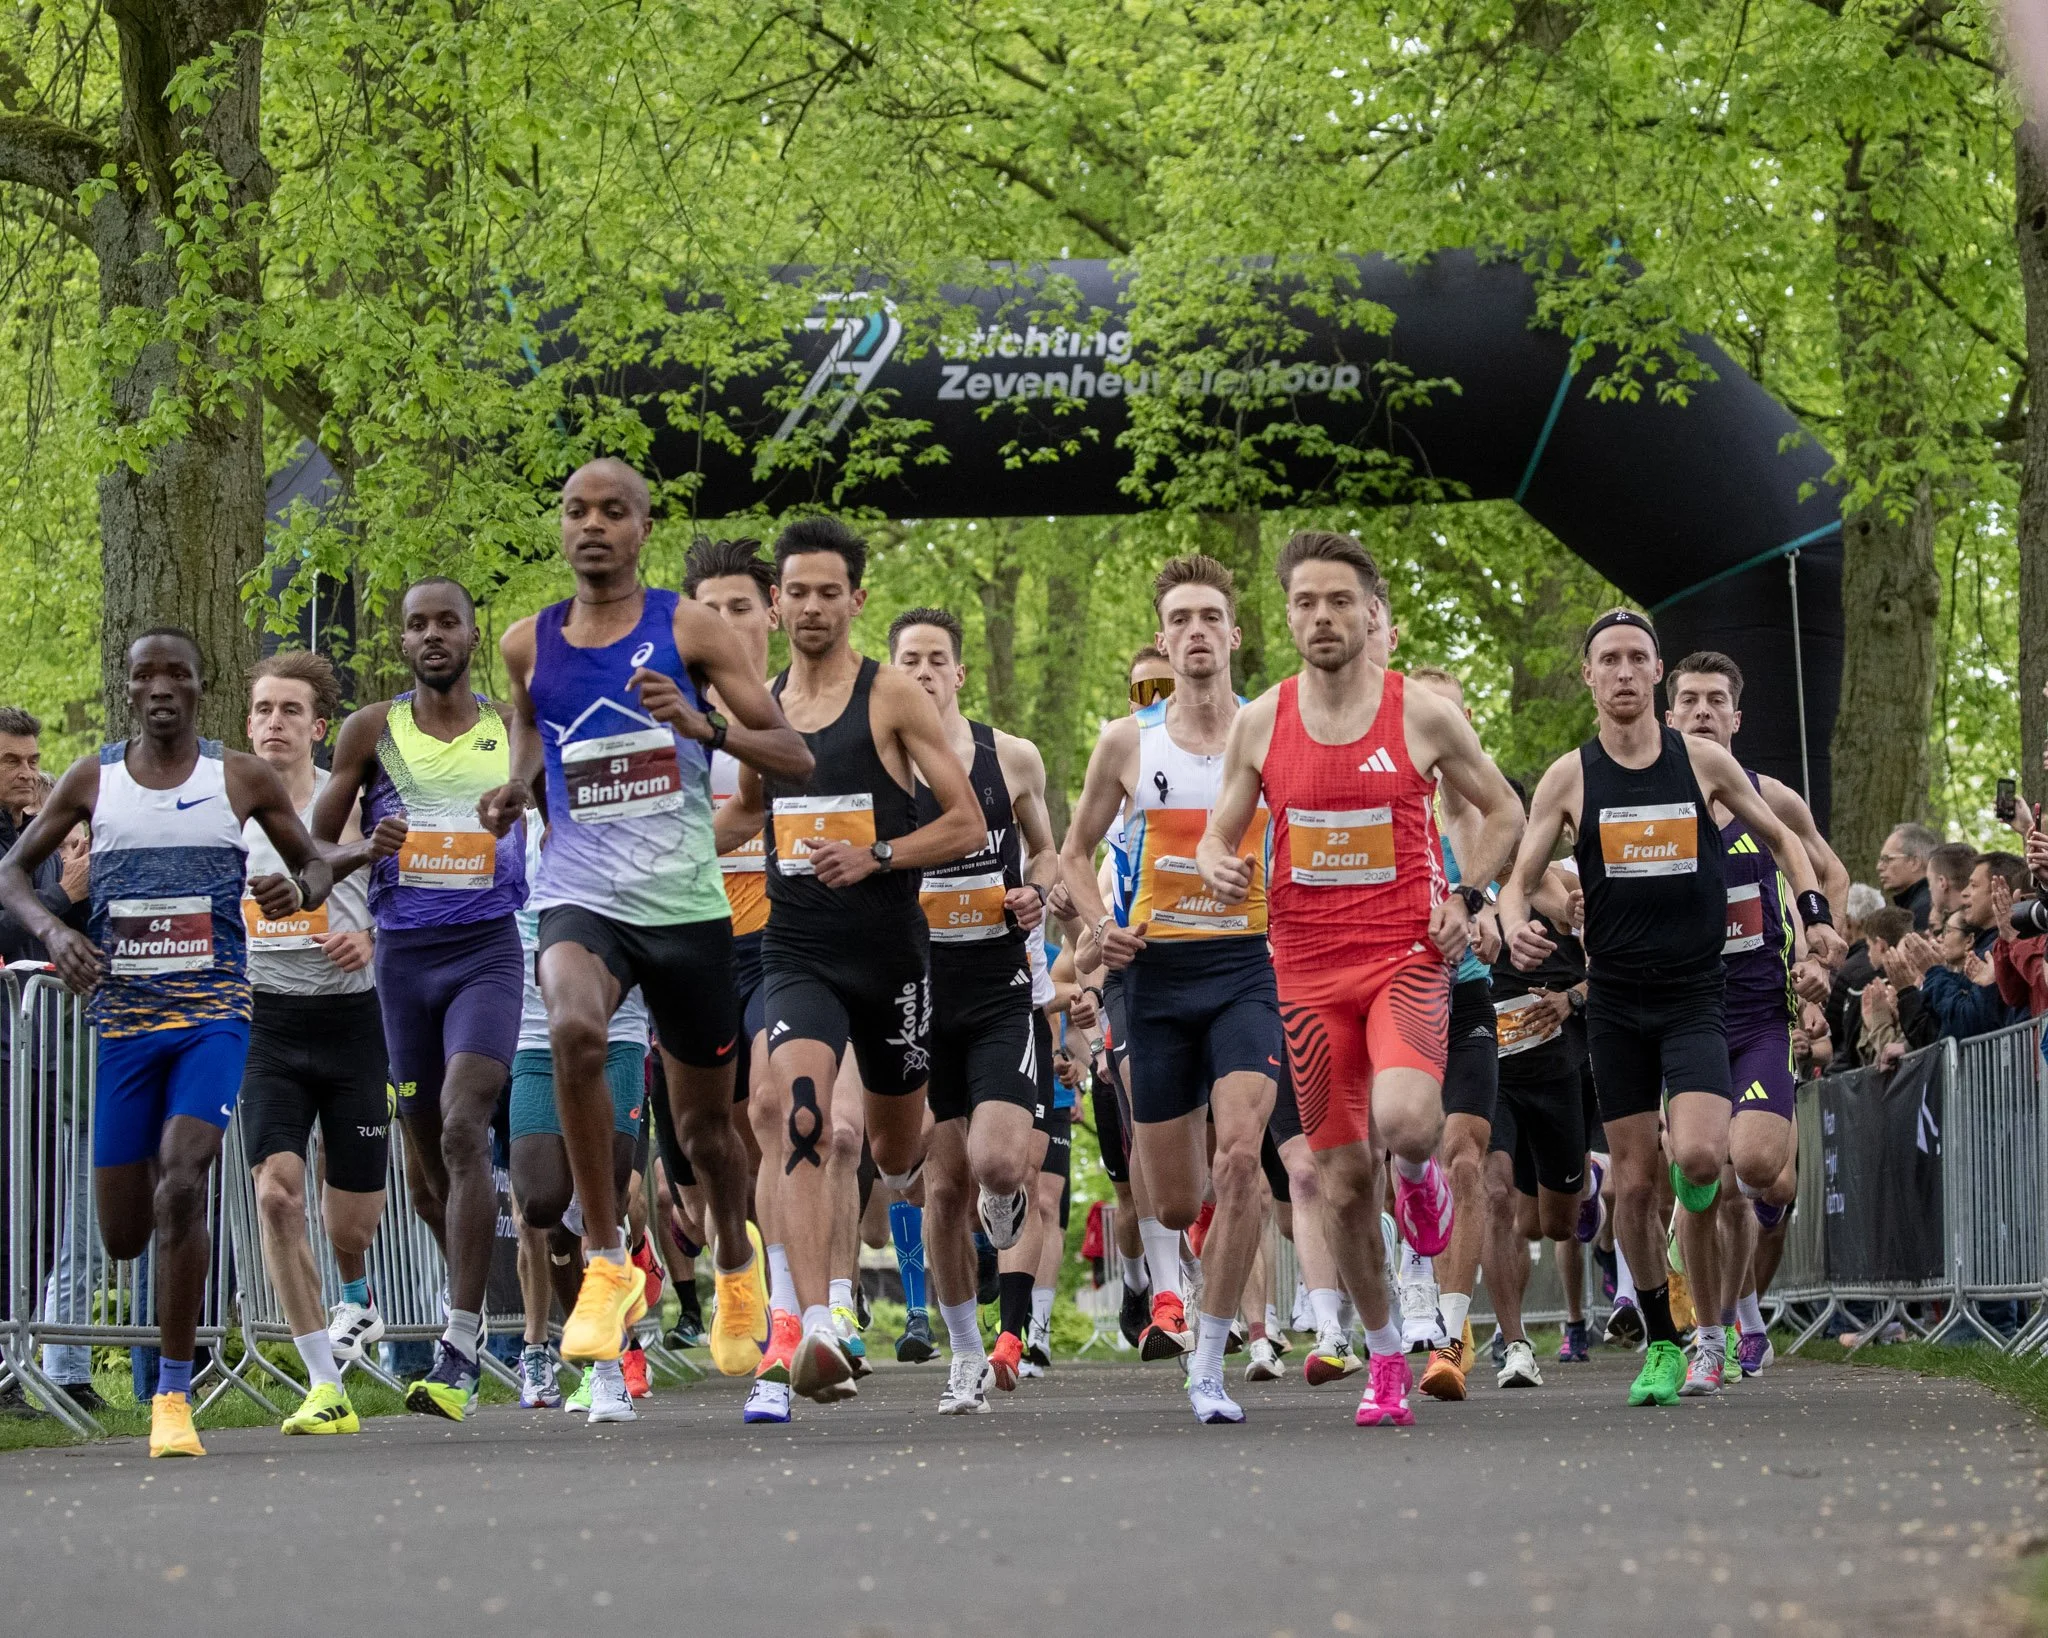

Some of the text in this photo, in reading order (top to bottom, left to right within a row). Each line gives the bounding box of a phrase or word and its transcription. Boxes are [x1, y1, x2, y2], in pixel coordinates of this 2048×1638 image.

[937, 360, 1361, 400] Zevenheuelenloop
[610, 758, 629, 775] 51
[577, 775, 671, 805] Biniyam
[814, 817, 825, 831] 5
[1644, 824, 1655, 837] 4
[442, 836, 454, 849] 2
[1327, 831, 1350, 845] 22
[1623, 841, 1679, 859] Frank
[408, 853, 487, 871] Mahadi
[936, 865, 960, 875] RUNNERS
[976, 858, 997, 868] RUNNERS
[1311, 850, 1369, 867] Daan
[1364, 871, 1391, 881] 2026
[959, 893, 971, 906] 11
[1175, 895, 1227, 913] Mike
[948, 909, 983, 925] Seb
[149, 918, 172, 933] 64
[256, 919, 310, 934] Paavo
[114, 937, 209, 957] Abraham
